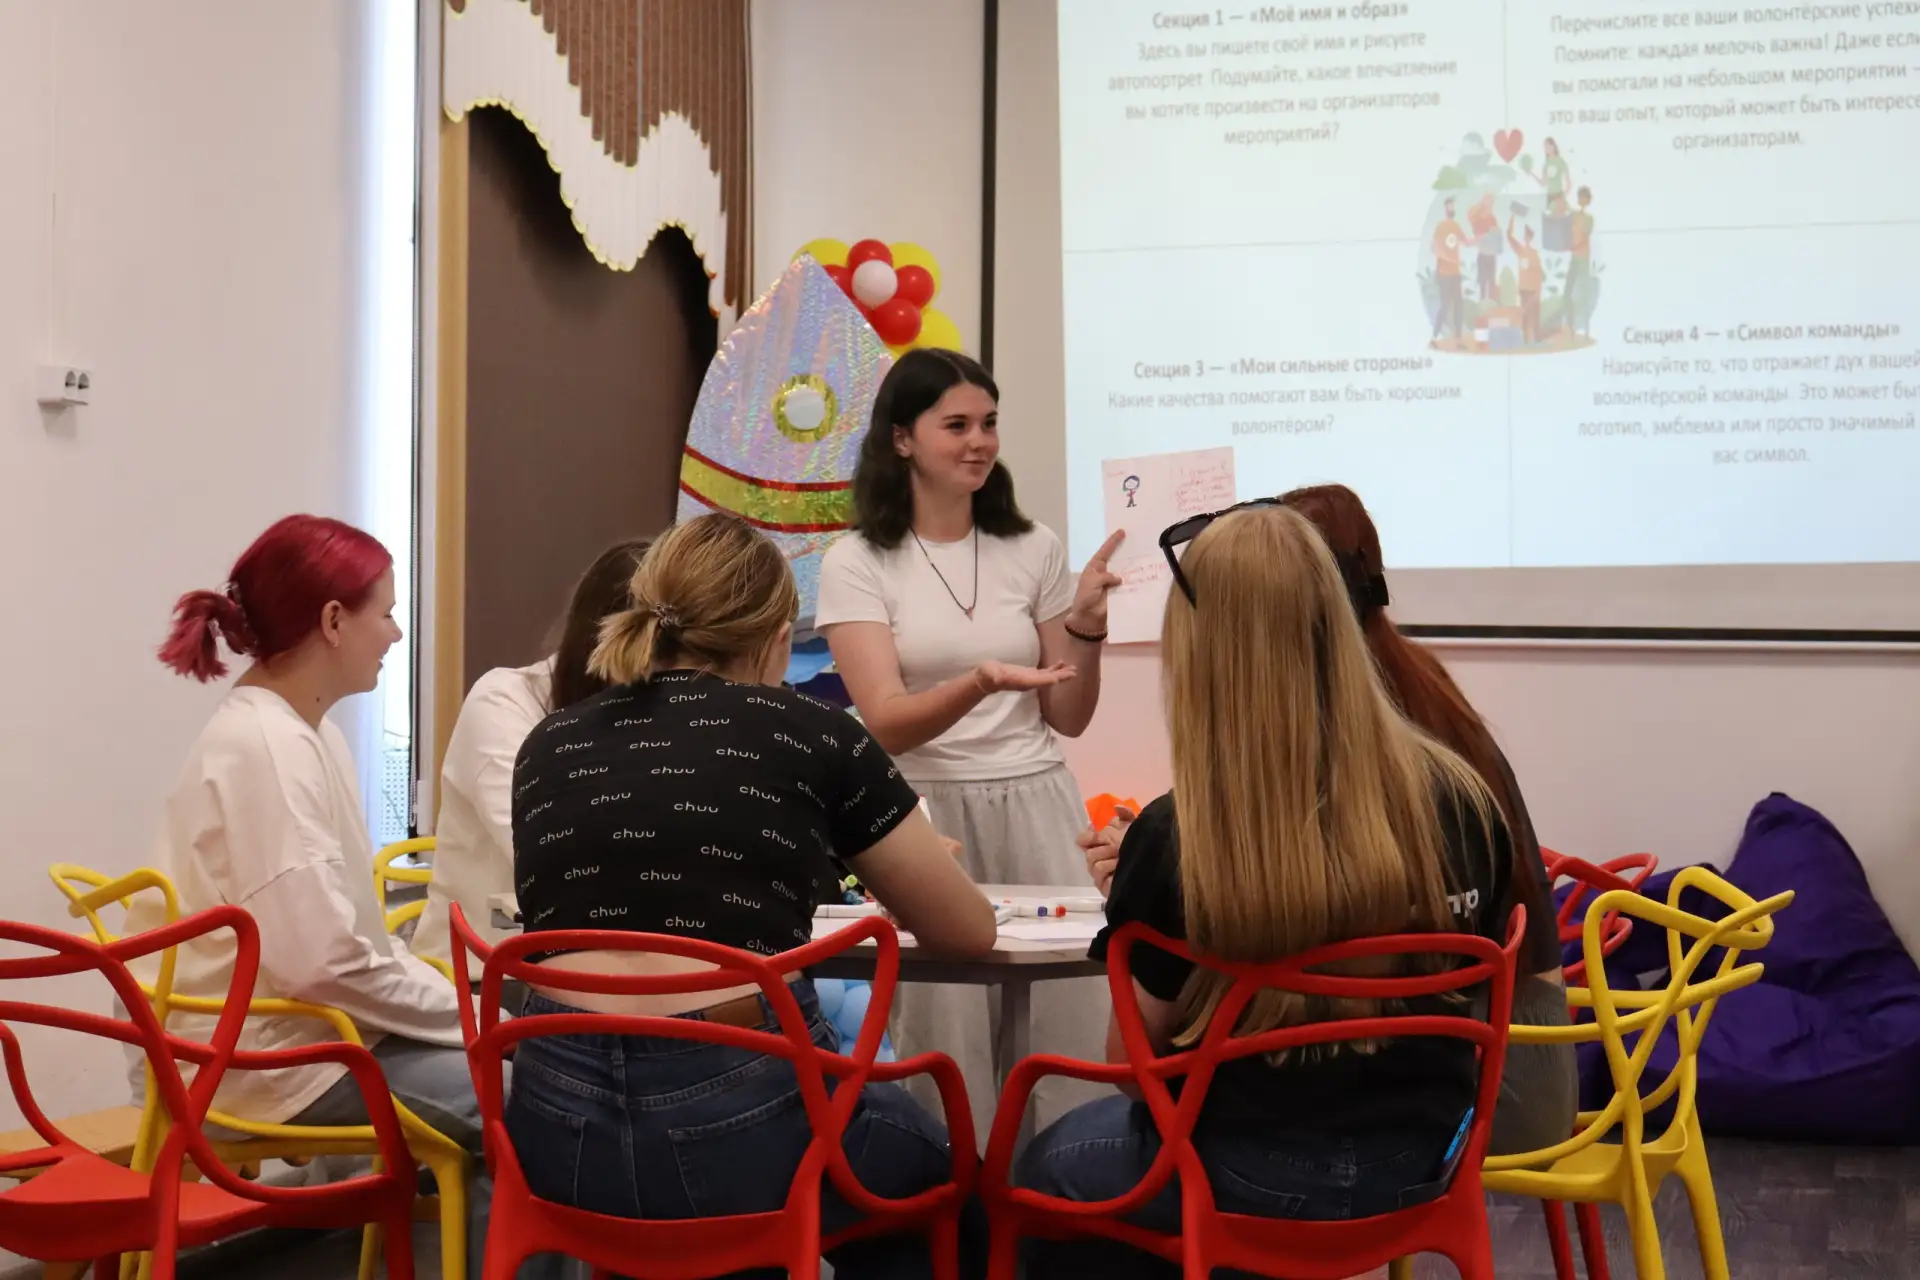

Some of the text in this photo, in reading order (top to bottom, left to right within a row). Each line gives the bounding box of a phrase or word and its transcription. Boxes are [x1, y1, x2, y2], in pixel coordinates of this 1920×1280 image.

[1153, 12, 1209, 33] Секция
[1215, 10, 1223, 26] 1
[1250, 4, 1295, 24] «Моё
[1300, 6, 1332, 22] имя
[1337, 6, 1347, 19] и
[1351, 0, 1408, 22] образ»
[1550, 14, 1658, 34] Перечислите
[1662, 13, 1689, 27] все
[1695, 10, 1737, 26] ваши
[1744, 3, 1861, 23] волонтёрские
[1136, 31, 1426, 61] Здесь вы пишете своё имя и рисуете
[1555, 44, 1632, 63] Помните:
[1638, 42, 1698, 60] каждая
[1703, 40, 1765, 57] мелочь
[1770, 32, 1829, 53] важна!
[1834, 30, 1881, 54] Даже
[1211, 62, 1303, 88] Подумайте,
[1307, 64, 1352, 81] какое
[1356, 59, 1458, 79] впечатление
[1552, 79, 1573, 94] вы
[1578, 76, 1658, 93] помогали
[1662, 74, 1682, 89] на
[1688, 64, 1785, 87] небольшом
[1791, 64, 1906, 87] мероприятии
[1125, 90, 1440, 121] вы хотите произвести на организаторов
[1547, 109, 1573, 125] это
[1578, 108, 1610, 123] ваш
[1616, 105, 1659, 124] опыт,
[1665, 97, 1736, 121] который
[1740, 100, 1795, 116] может
[1800, 93, 1840, 113] быть
[1224, 122, 1340, 147] мероприятий?
[1672, 131, 1804, 153] организаторам.
[1624, 327, 1684, 347] Секция
[1690, 325, 1699, 341] 4
[1727, 323, 1802, 341] «Символ
[1807, 323, 1899, 342] команды»
[1134, 361, 1190, 381] Секция
[1196, 360, 1204, 376] 3
[1230, 358, 1275, 374] «Мои
[1280, 356, 1349, 373] сильные
[1354, 356, 1432, 376] стороны»
[1603, 349, 1920, 377] Нарисуйте то, что отражает дух вашей
[1108, 381, 1461, 408] Какие качества помогают вам быть хорошим
[1593, 384, 1707, 408] волонтёрской
[1799, 382, 1828, 400] Это
[1832, 384, 1888, 400] может
[1231, 414, 1334, 436] волонтёром?
[1578, 411, 1915, 437] логотип, эмблема или просто значимый
[1713, 446, 1811, 465] вас символ.
[669, 692, 708, 703] chuu
[746, 696, 786, 709] chuu
[796, 694, 830, 710] chuu
[546, 718, 579, 732] chuu
[614, 717, 653, 727] chuu
[689, 718, 730, 727] chuu
[555, 741, 593, 754] chuu
[629, 741, 671, 750] chuu
[774, 733, 812, 754] chuu
[853, 736, 869, 757] chuu
[716, 747, 760, 760] chuu
[568, 766, 609, 779] chuu
[651, 766, 695, 775] chuu
[590, 791, 631, 806] chuu
[739, 785, 781, 803] chuu
[525, 800, 553, 822] chuu
[674, 801, 719, 813] chuu
[870, 805, 898, 833] chuu
[539, 827, 574, 845] chuu
[612, 828, 656, 840] chuu
[762, 829, 797, 849] chuu
[701, 844, 743, 861] chuu
[564, 864, 600, 880] chuu
[640, 870, 681, 881] chuu
[772, 880, 798, 901] chuu
[723, 893, 761, 909] chuu
[589, 906, 628, 919] chuu
[665, 916, 706, 929] chuu
